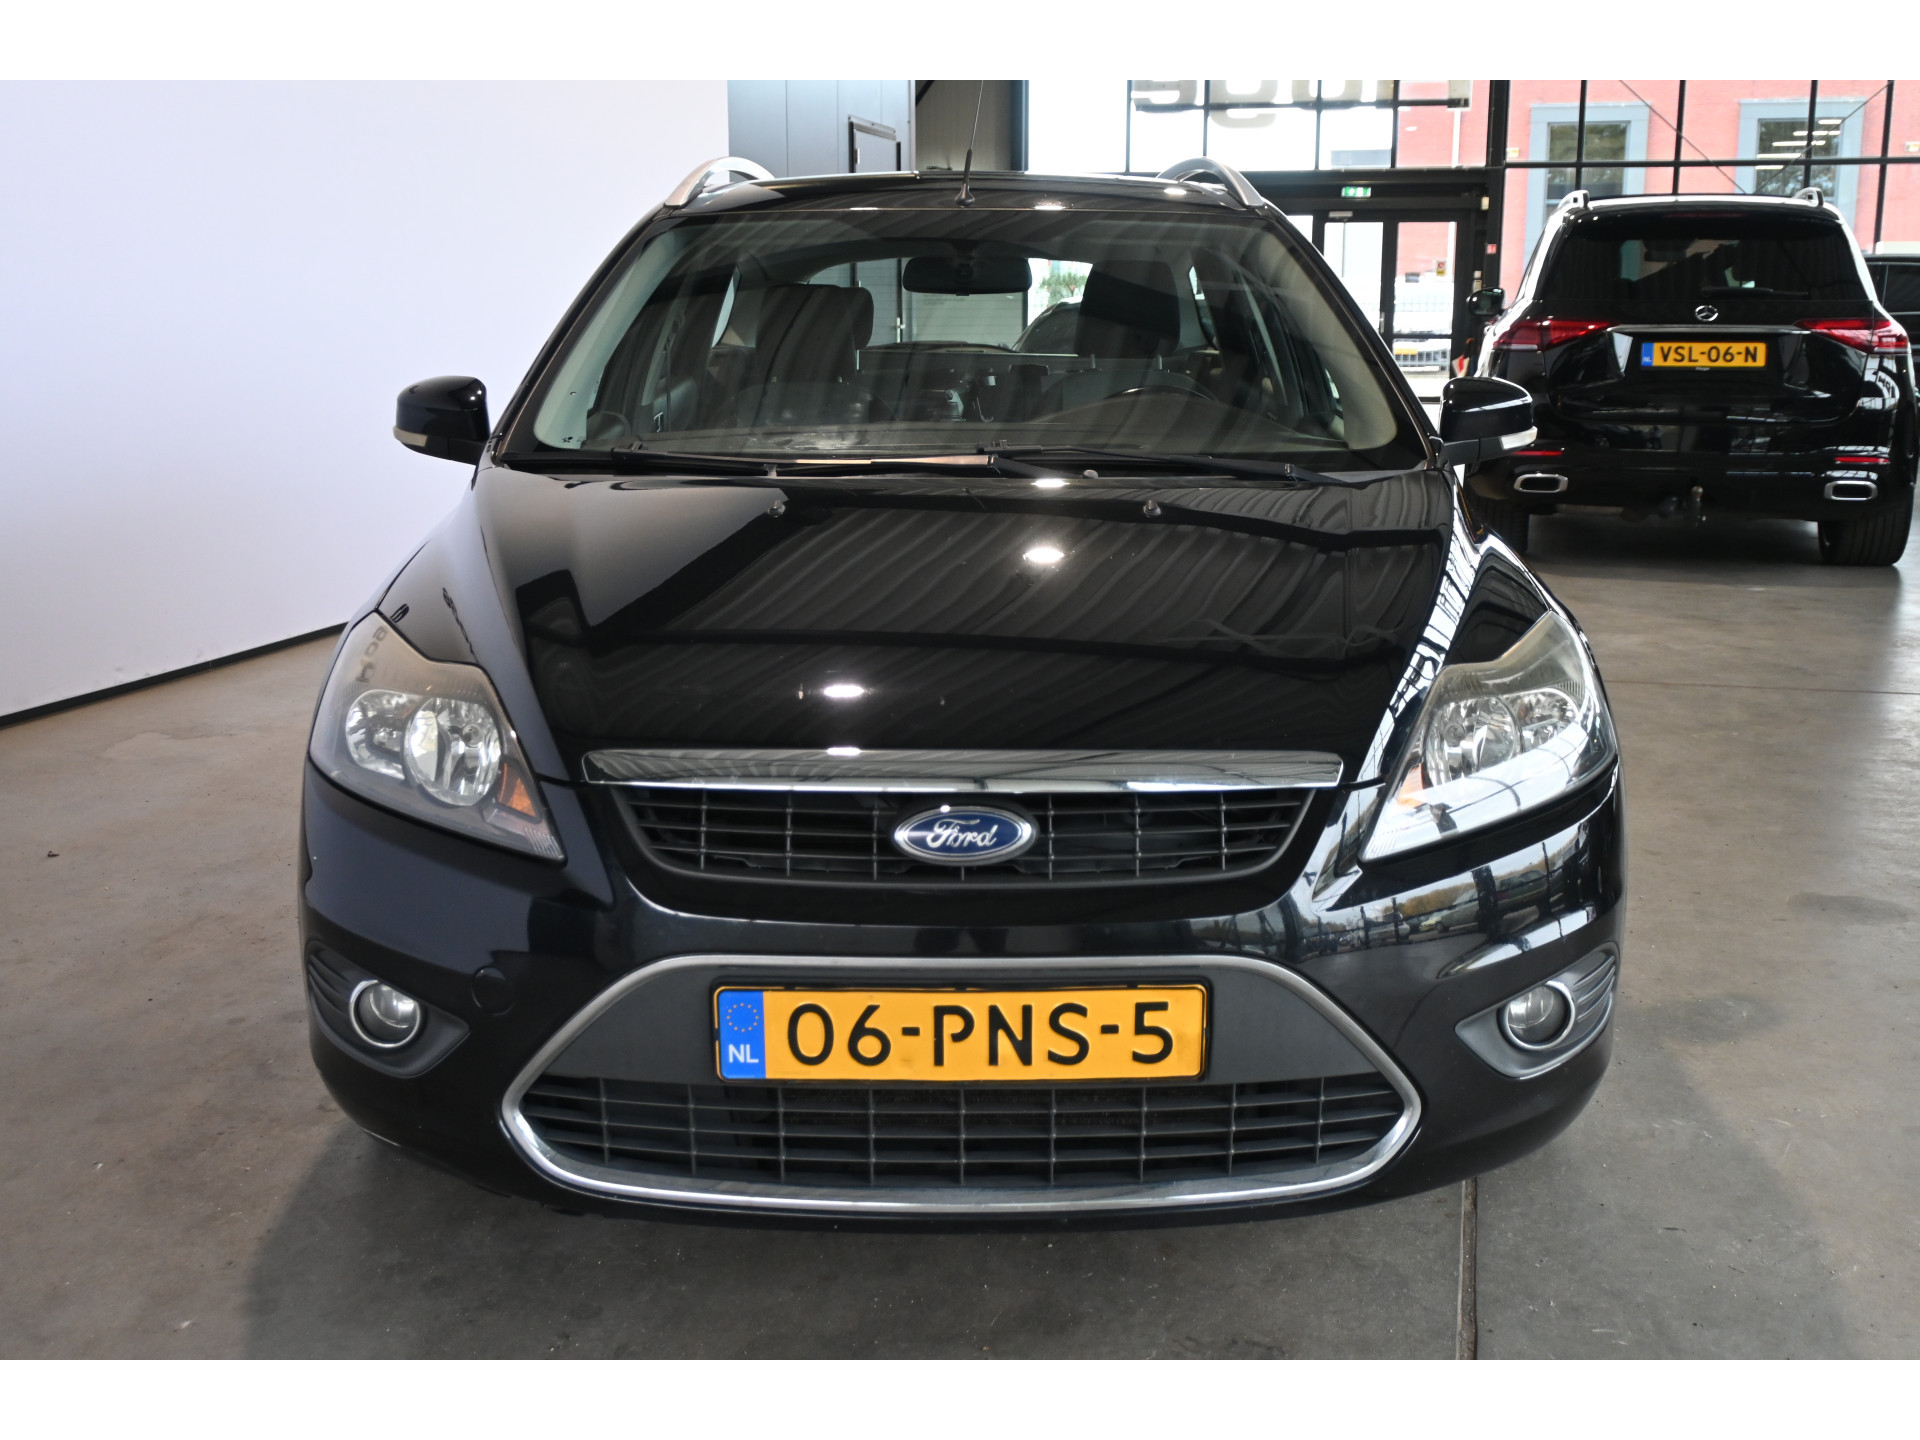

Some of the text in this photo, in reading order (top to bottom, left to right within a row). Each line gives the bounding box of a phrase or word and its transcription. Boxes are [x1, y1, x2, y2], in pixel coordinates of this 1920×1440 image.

[1659, 345, 1759, 364] VSL-06-N
[925, 818, 999, 849] Ford
[786, 1000, 1175, 1067] 06-PNS-5
[727, 1043, 760, 1064] NL
